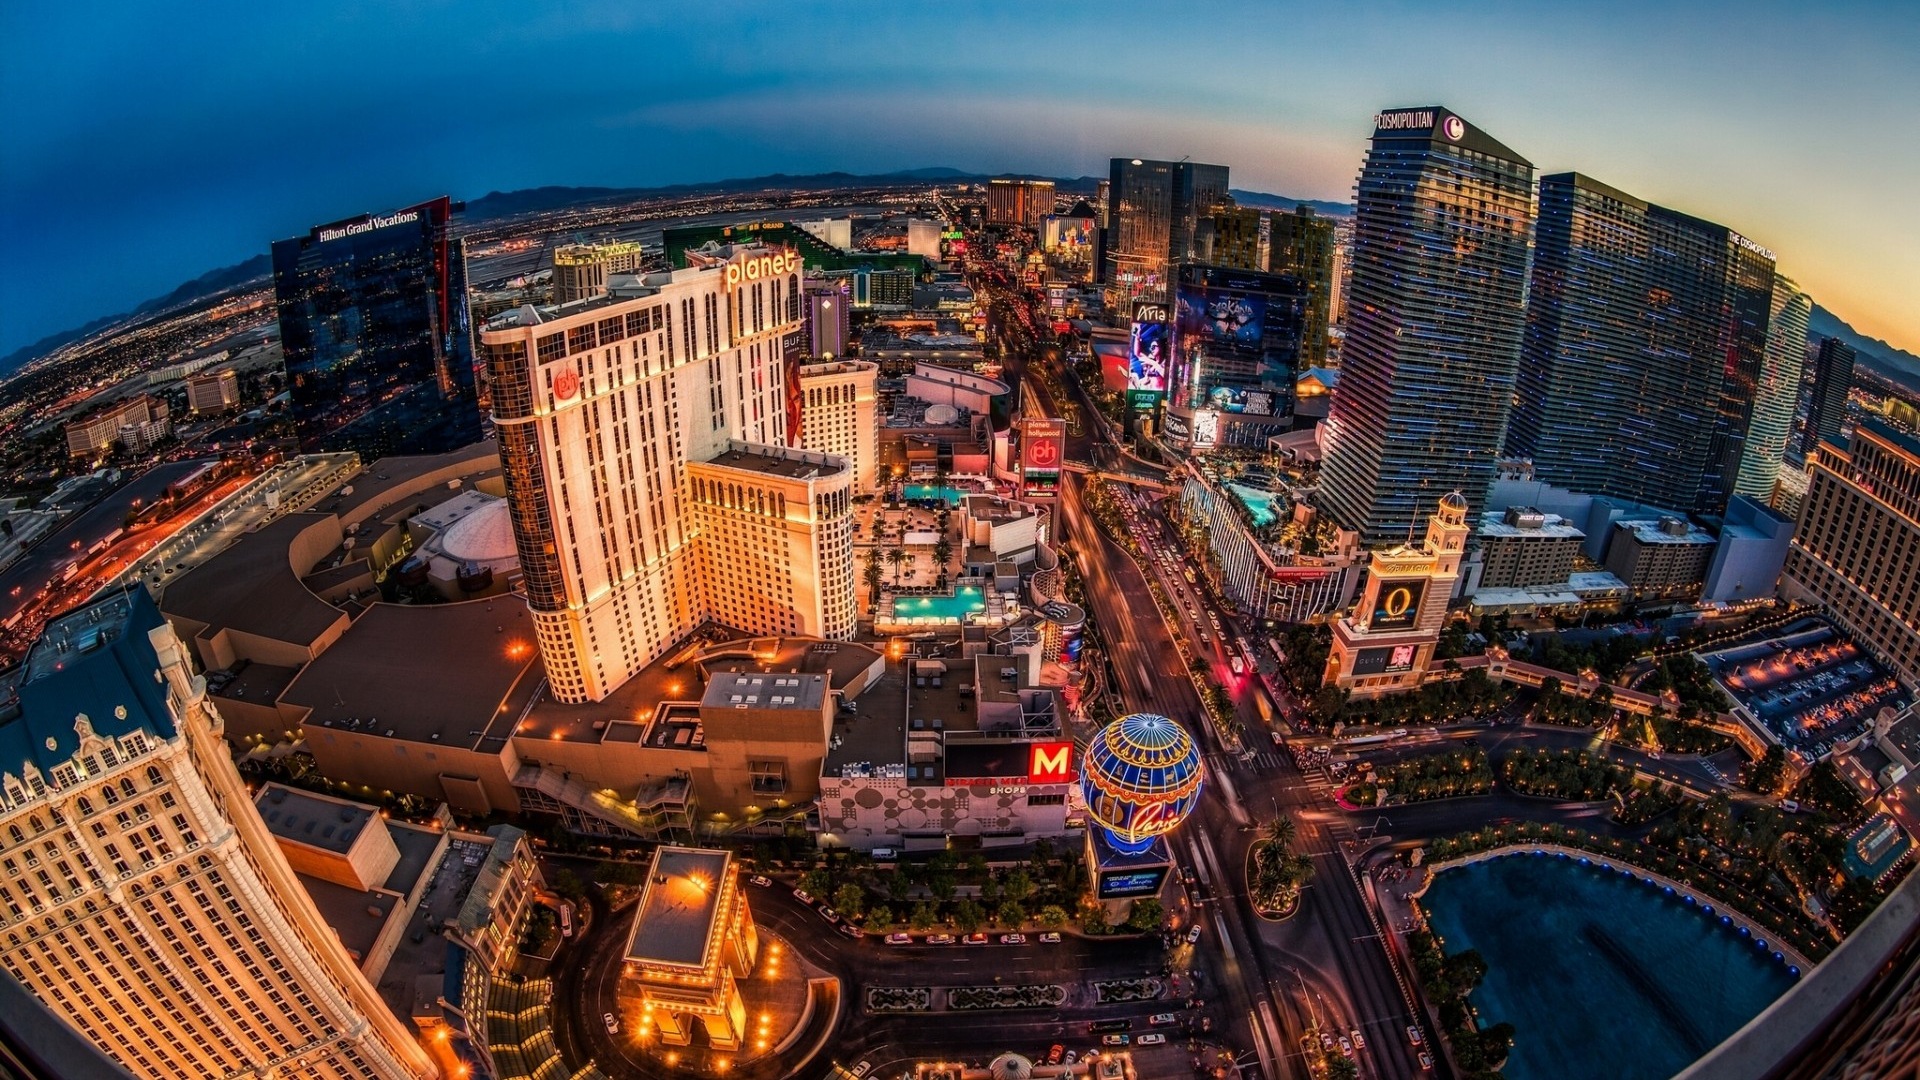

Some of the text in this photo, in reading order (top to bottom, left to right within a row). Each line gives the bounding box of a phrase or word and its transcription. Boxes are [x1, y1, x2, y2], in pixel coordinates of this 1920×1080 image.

[1378, 112, 1433, 129] COSMOPOLITAN
[320, 211, 418, 242] Hilton Grand Vacations
[941, 231, 963, 239] MGM
[1729, 231, 1777, 262] THE COSMOPOLITAN
[726, 249, 796, 293] planet
[1136, 305, 1166, 322] Aria
[1028, 421, 1050, 429] planet
[1028, 429, 1060, 437] hollywood
[1033, 440, 1056, 462] ph
[1385, 588, 1411, 616] O
[1033, 746, 1069, 776] M
[989, 786, 1026, 794] SHOPS
[1130, 802, 1180, 844] Paris
